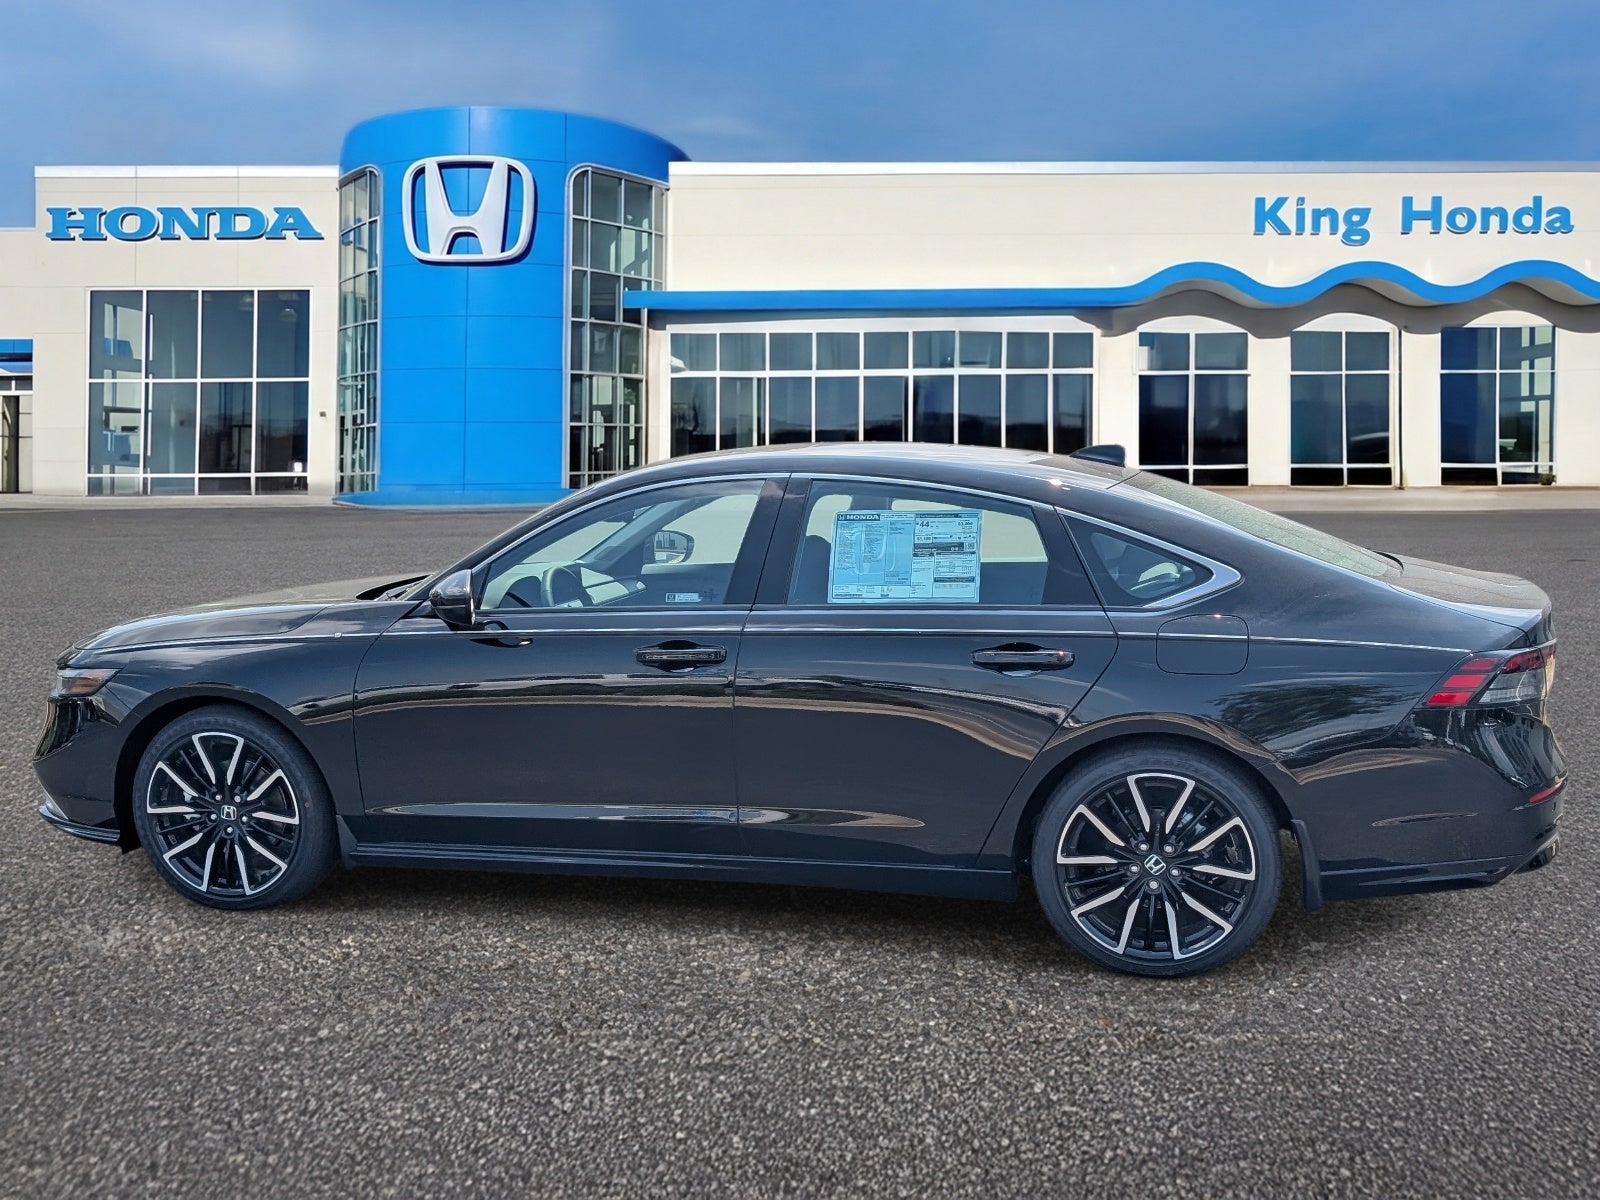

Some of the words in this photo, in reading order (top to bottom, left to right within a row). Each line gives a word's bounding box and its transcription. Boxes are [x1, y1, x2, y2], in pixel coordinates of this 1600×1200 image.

[45, 206, 324, 240] HONDA
[1253, 196, 1373, 246] King
[1401, 195, 1575, 235] Honda
